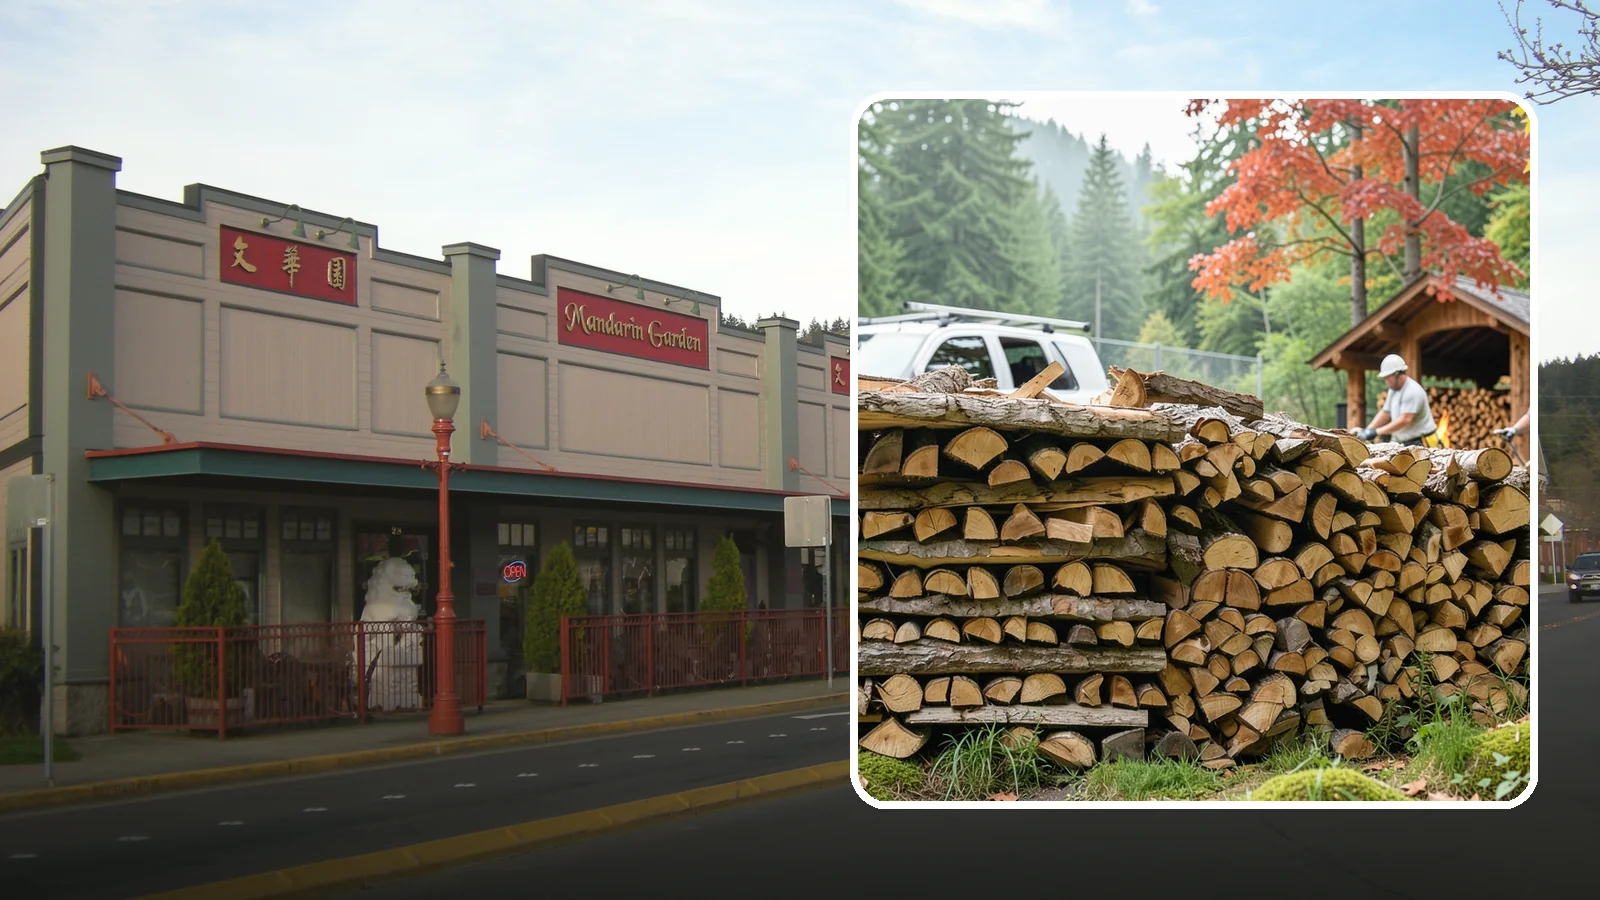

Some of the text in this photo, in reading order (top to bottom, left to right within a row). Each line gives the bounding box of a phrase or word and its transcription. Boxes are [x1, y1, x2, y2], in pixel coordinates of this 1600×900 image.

[231, 236, 346, 291] 文華園
[564, 302, 701, 352] Mandarin Garden
[503, 565, 527, 578] OPEN
